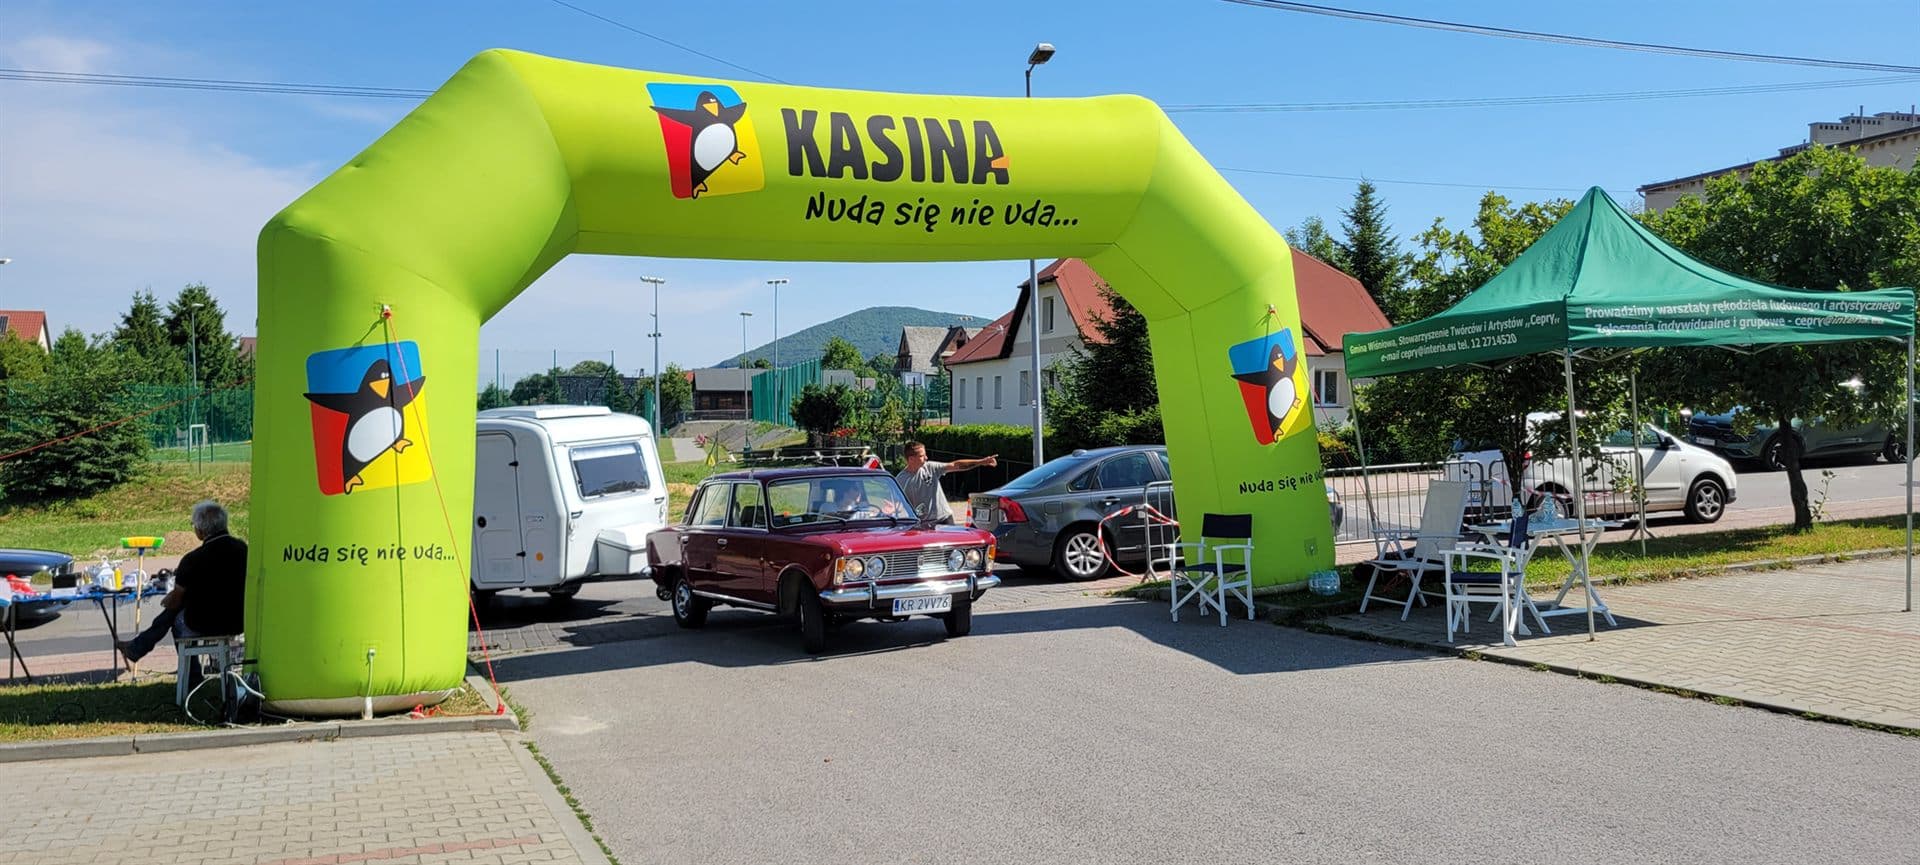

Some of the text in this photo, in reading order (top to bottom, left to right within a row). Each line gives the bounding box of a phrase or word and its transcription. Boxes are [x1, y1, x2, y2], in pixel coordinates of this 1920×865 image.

[781, 108, 1010, 185] KASINA
[805, 192, 1078, 232] Nuda się nie uda...
[1584, 305, 1654, 318] Prowadzimy
[1656, 302, 1710, 315] warsztaty
[1770, 299, 1820, 313] ludowego
[1823, 300, 1828, 310] i
[1829, 300, 1901, 313] artystycznego
[1399, 328, 1449, 345] Stowarzyszenie
[1451, 324, 1481, 336] Twórców
[1484, 321, 1487, 331] i
[1488, 316, 1524, 332] Artystów
[1657, 318, 1730, 333] indywidualne
[1733, 316, 1737, 327] i
[1740, 317, 1785, 330] grupowe
[1381, 333, 1518, 362] e-mail cepry@interia.eu tel. 12 2714520
[1239, 480, 1274, 494] Nuda
[1278, 475, 1297, 491] się
[1300, 472, 1313, 485] nie
[283, 543, 455, 566] Nuda się nie uda...
[901, 597, 949, 611] KR 2VV76
